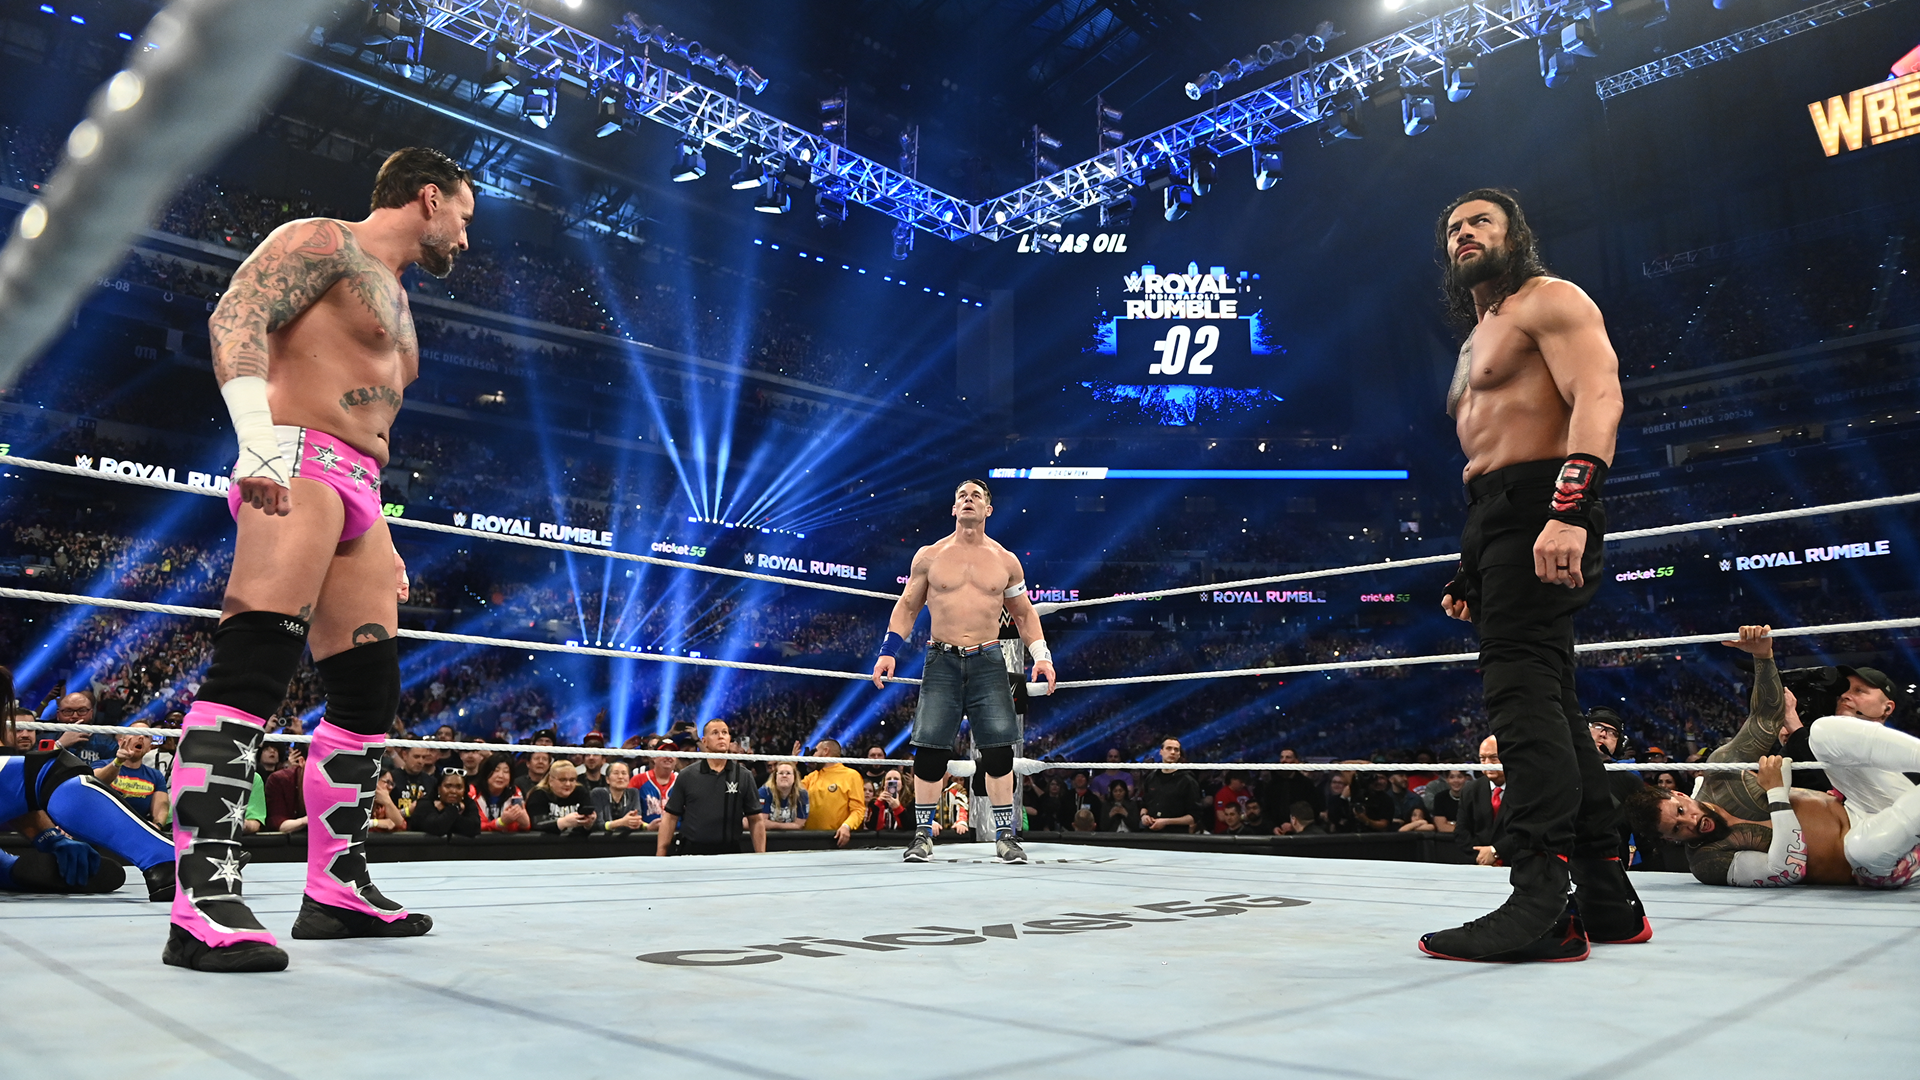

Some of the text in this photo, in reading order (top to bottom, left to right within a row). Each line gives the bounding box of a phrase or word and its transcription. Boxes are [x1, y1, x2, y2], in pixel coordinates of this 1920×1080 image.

[1092, 233, 1128, 254] OIL
[1145, 274, 1236, 294] ROYAL
[1126, 299, 1238, 320] RUMBLE
[1145, 293, 1220, 301] INDIANAPOLIS
[1148, 324, 1220, 376] :02
[442, 353, 499, 373] DICKERSON
[1814, 380, 1911, 405] DWIGHT FREENEY
[1642, 409, 1754, 436] ROBERT MATHIS 2003-16
[98, 456, 177, 482] ROYAL
[471, 513, 536, 538] ROYAL
[538, 522, 614, 547] RUMBLE
[757, 553, 807, 574] ROYAL
[809, 560, 868, 581] RUMBLE
[1736, 550, 1802, 571] ROYAL
[1805, 540, 1890, 563] RUMBLE
[1213, 591, 1263, 603] ROYAL
[1266, 590, 1326, 603] RUMBLE
